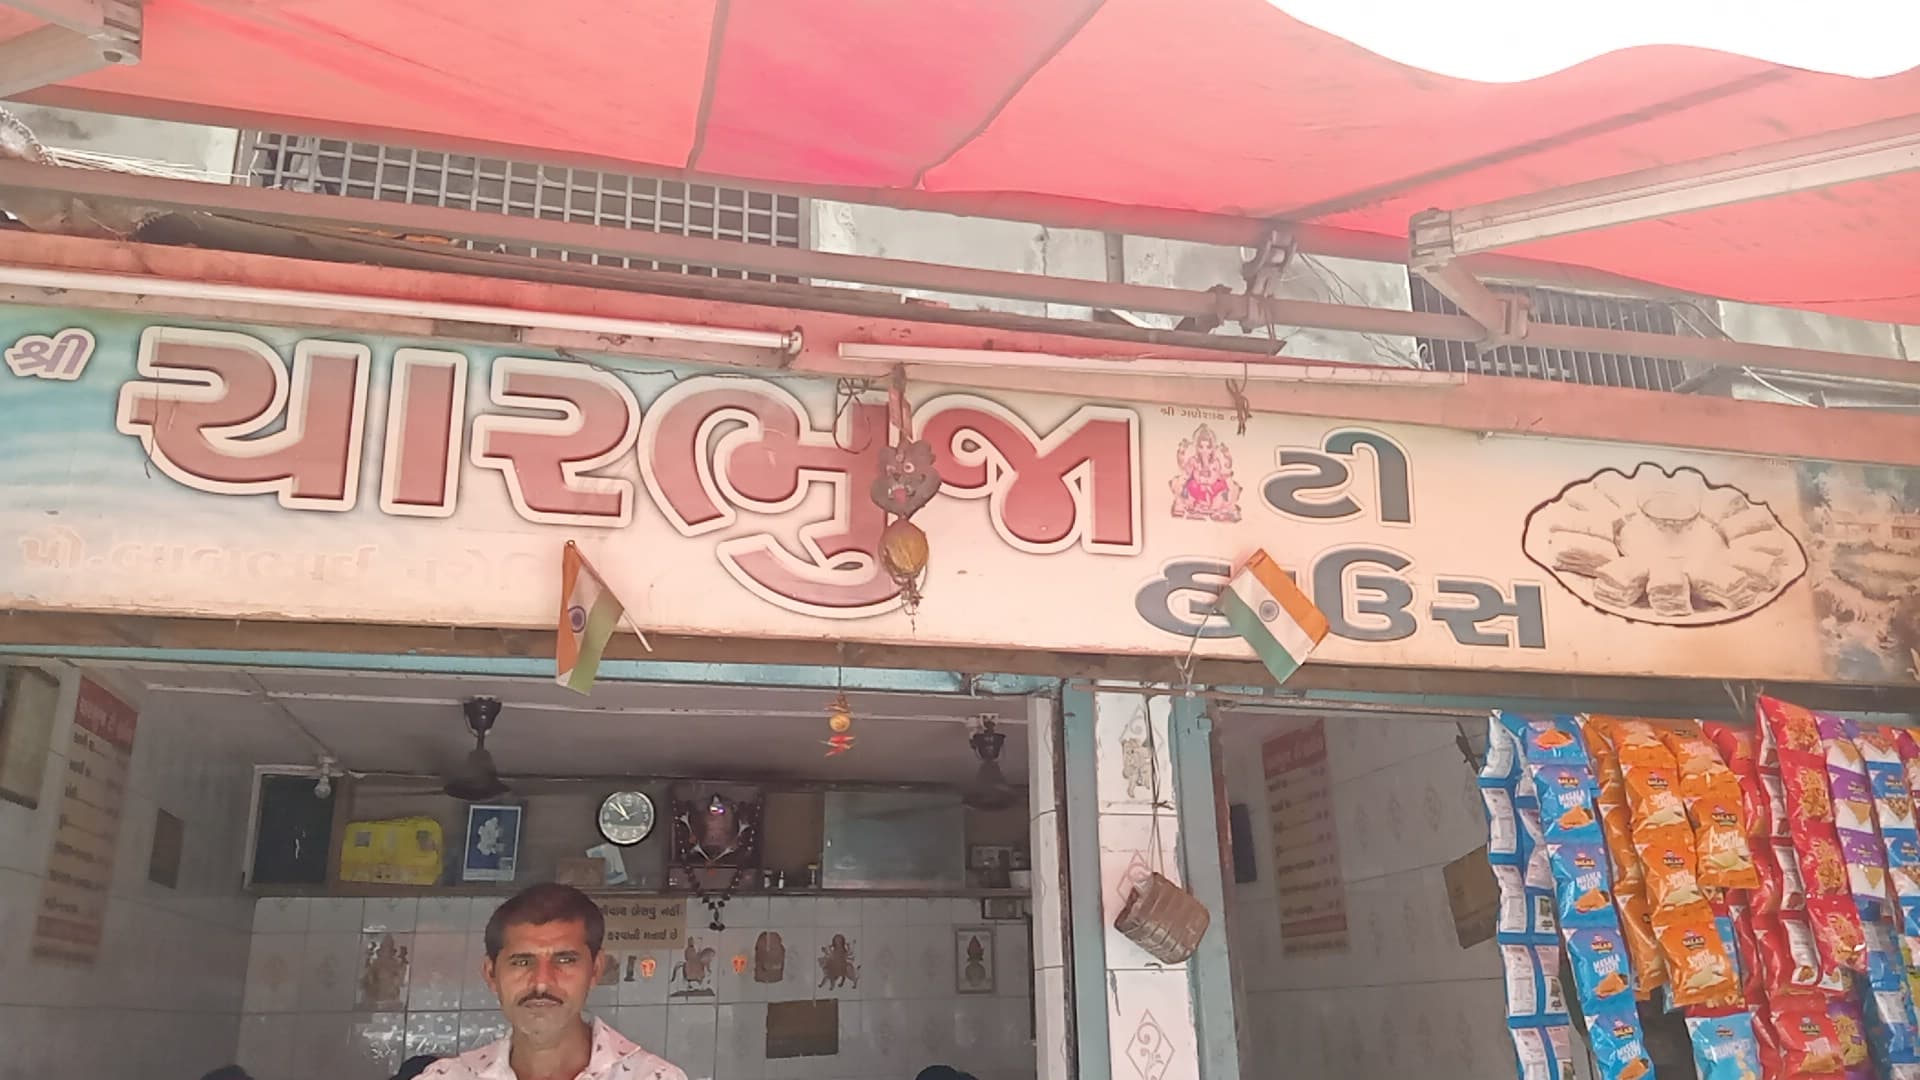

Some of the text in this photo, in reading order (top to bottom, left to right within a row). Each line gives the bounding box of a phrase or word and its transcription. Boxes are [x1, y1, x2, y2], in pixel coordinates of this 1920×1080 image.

[8, 328, 1140, 617] શ્રી ચારભુજા
[1261, 428, 1414, 526] ટી
[1135, 546, 1548, 649] હઉસ
